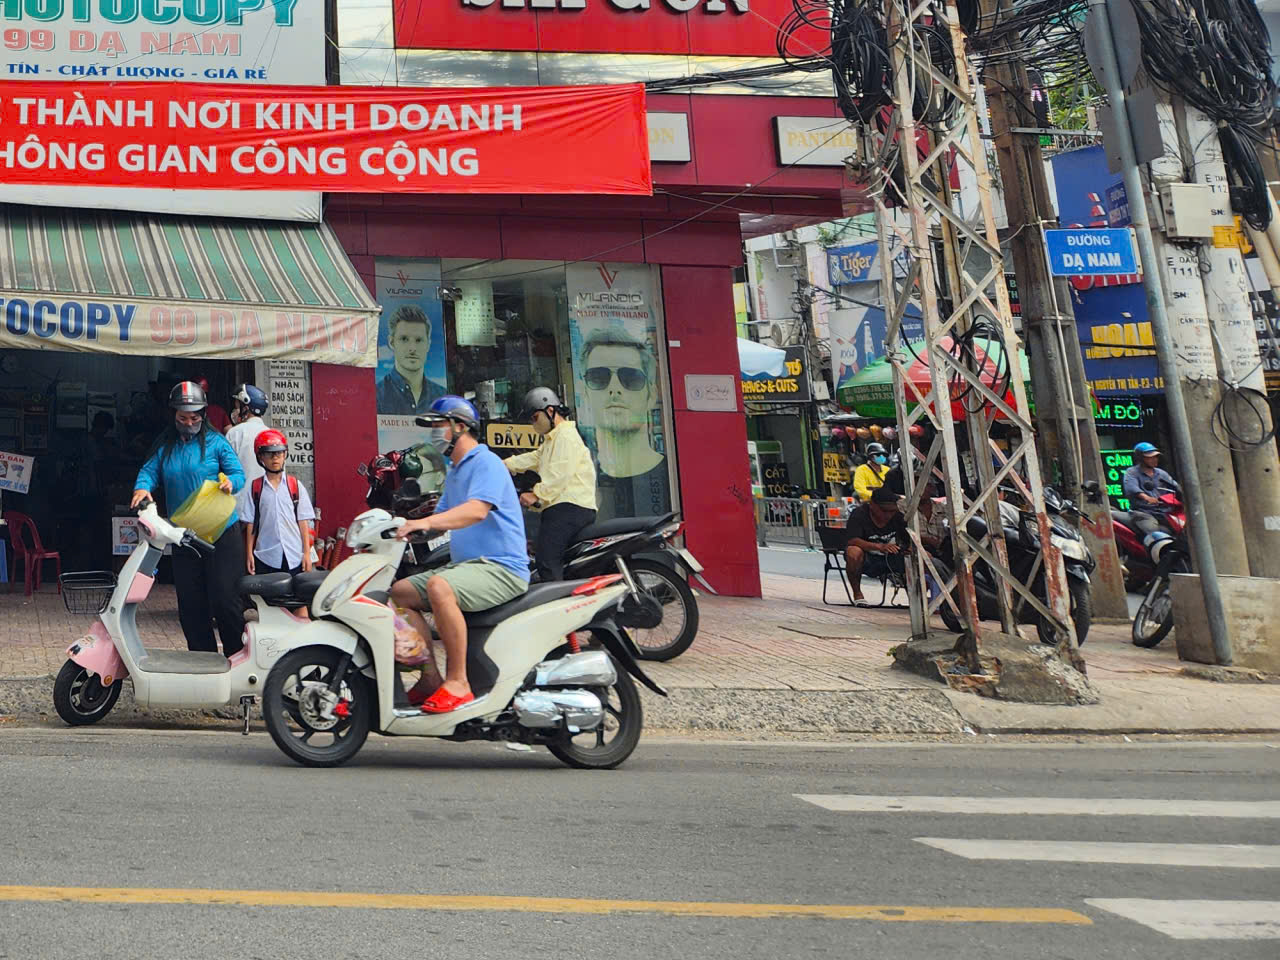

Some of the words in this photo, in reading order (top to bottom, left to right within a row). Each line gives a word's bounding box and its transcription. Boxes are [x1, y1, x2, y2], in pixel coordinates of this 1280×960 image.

[3, 28, 56, 52] 99
[68, 29, 127, 59] DẠ
[140, 31, 242, 57] NAM
[7, 61, 39, 74] TÍN
[58, 62, 111, 76] CHẤT
[117, 66, 185, 80] LƯỢNG
[204, 66, 239, 79] GIÁ
[245, 65, 267, 80] RẺ
[12, 91, 153, 128] THÀNH
[168, 98, 241, 129] NƠI
[255, 102, 355, 131] KINH
[369, 103, 522, 131] DOANH
[118, 142, 217, 173] GIAN
[230, 134, 347, 176] CÔNG
[359, 141, 480, 182] CỘNG
[1067, 233, 1111, 246] ĐƯỜNG
[841, 251, 872, 276] Tiger
[1062, 253, 1084, 271] DẠ
[1087, 252, 1121, 267] NAM
[577, 309, 597, 318] MADE
[600, 310, 609, 318] IN
[611, 310, 649, 319] THAILAND
[150, 306, 198, 345] 99
[275, 312, 369, 354] NAM
[275, 380, 299, 390] NHẬN
[287, 390, 304, 402] SÁCH
[289, 402, 304, 415] SÁCH
[380, 419, 402, 427] MADE
[403, 419, 411, 427] IN
[289, 430, 308, 438] BÁN
[494, 425, 522, 447] ĐẨY
[289, 452, 314, 465] VIỆC
